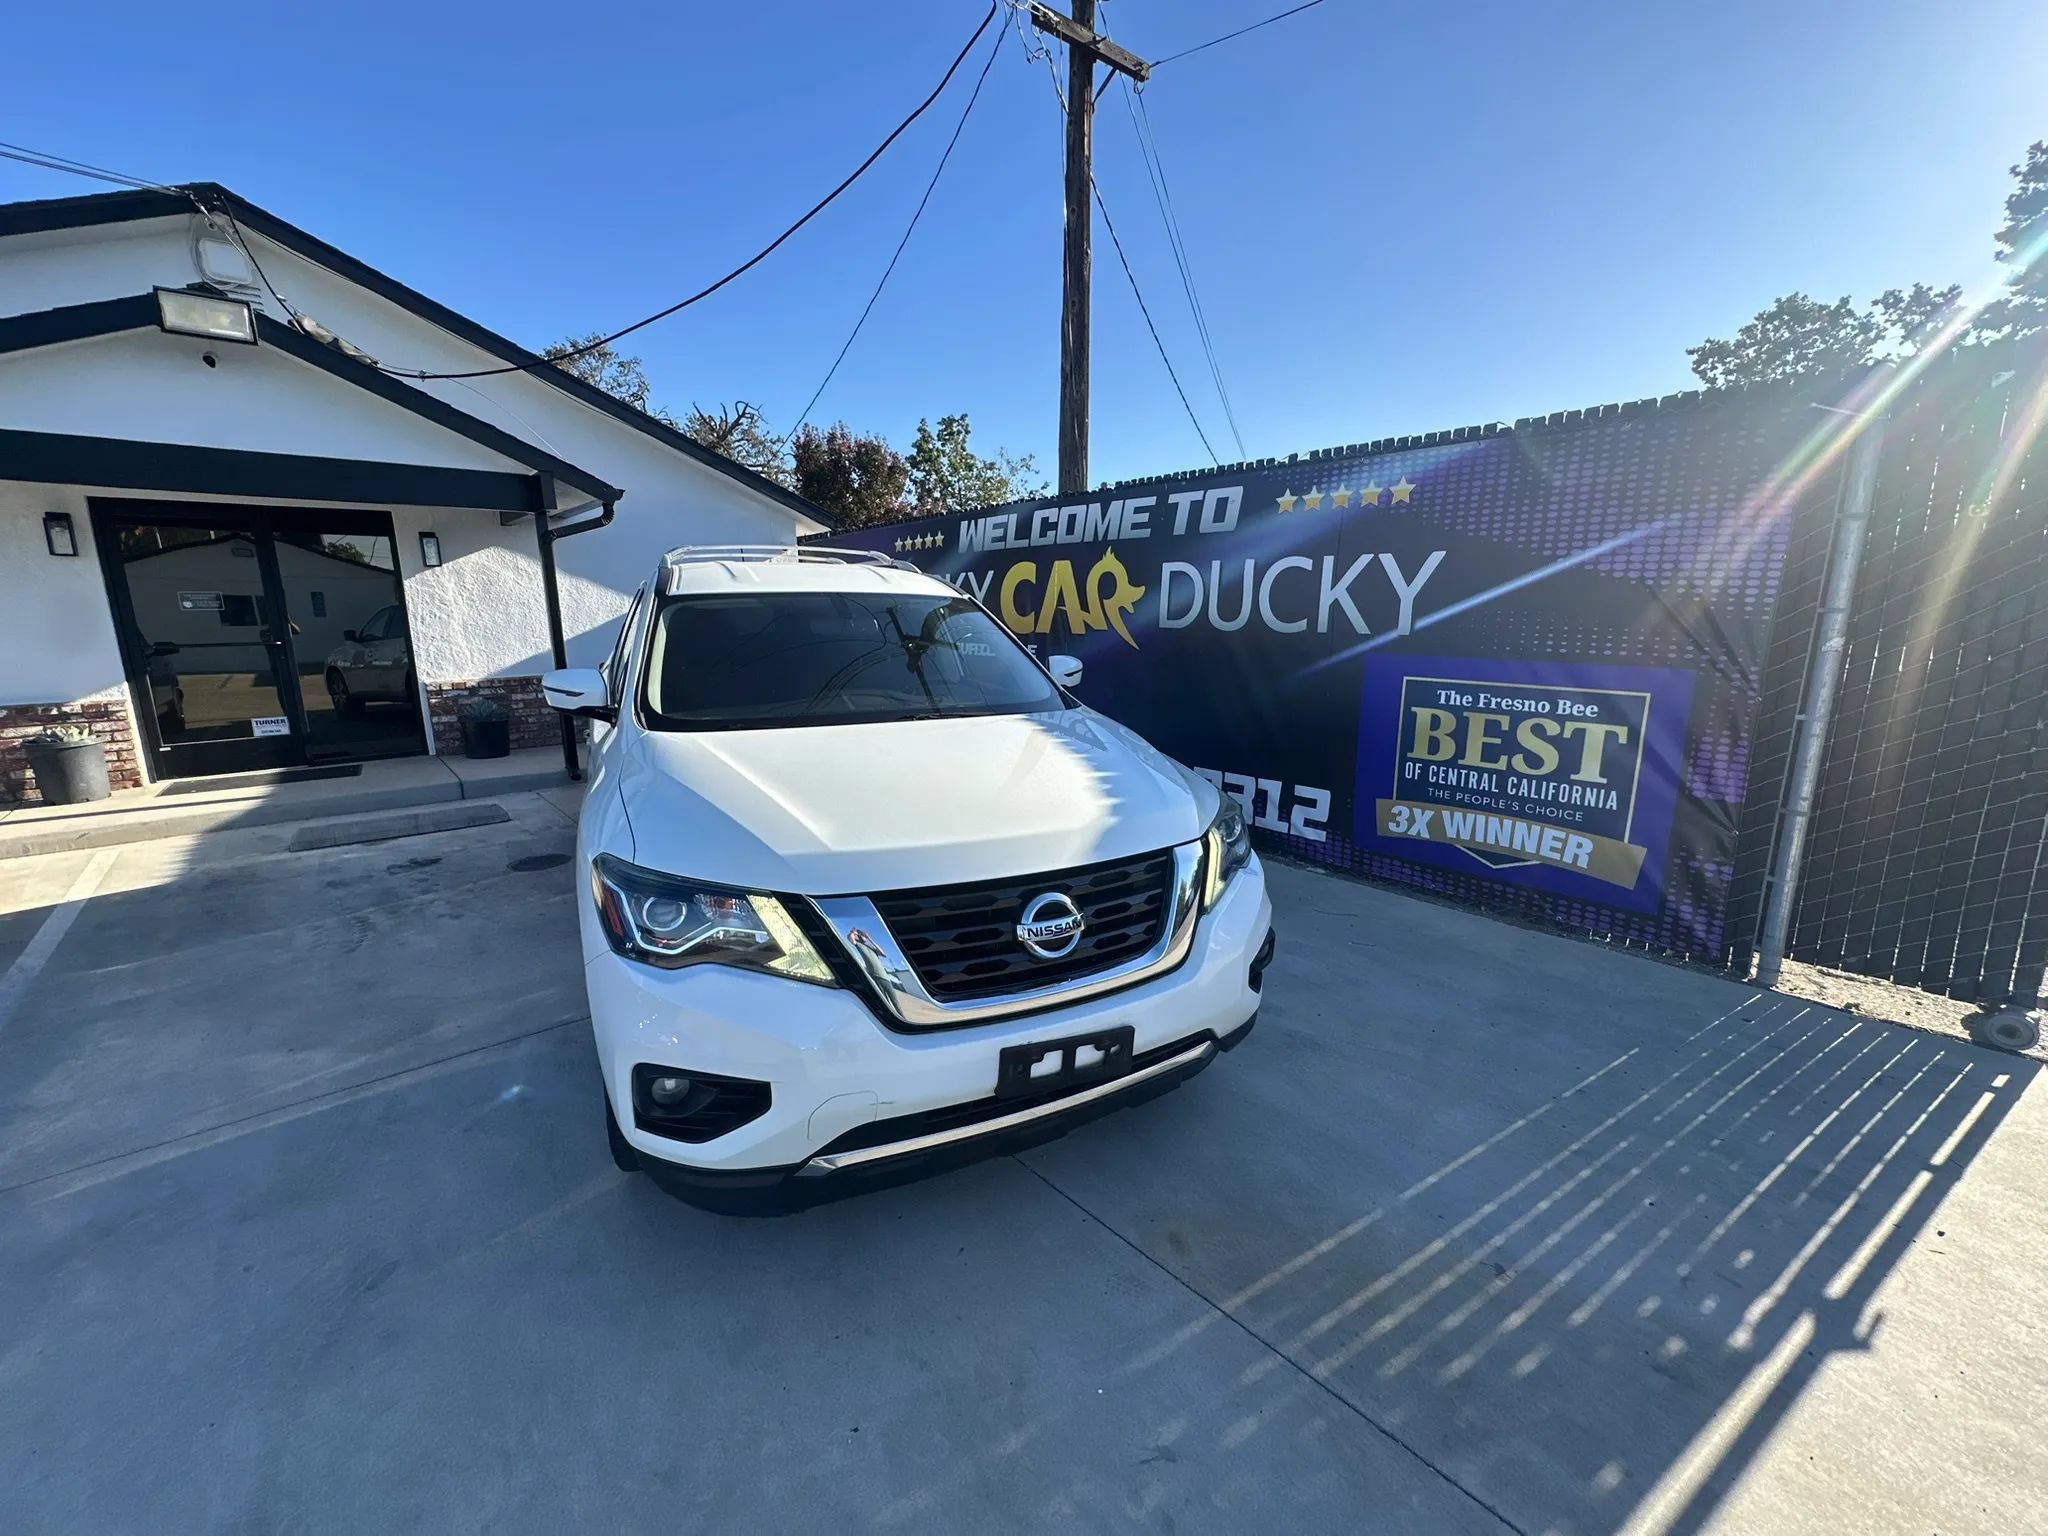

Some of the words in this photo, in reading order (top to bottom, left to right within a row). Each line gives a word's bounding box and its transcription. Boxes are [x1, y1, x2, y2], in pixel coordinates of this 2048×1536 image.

[958, 496, 1157, 553] WELCOME
[1168, 486, 1244, 536] TO
[1000, 545, 1146, 650] CAR
[1158, 550, 1447, 636] DUCKY
[1437, 689, 1473, 707] The
[1477, 693, 1551, 713] Fresno
[1556, 699, 1599, 718] Bee
[1406, 706, 1628, 784] BEST
[1405, 761, 1422, 779] OF
[1428, 765, 1499, 793] CENTRAL
[1507, 776, 1617, 811] CALIFORNIA
[1428, 787, 1451, 800] THE
[1456, 792, 1520, 811] PEOPLE'S
[1525, 803, 1584, 822] CHOICE
[1388, 805, 1435, 839] 3X
[1441, 810, 1594, 869] WINNER
[1027, 917, 1082, 938] NISSAN
